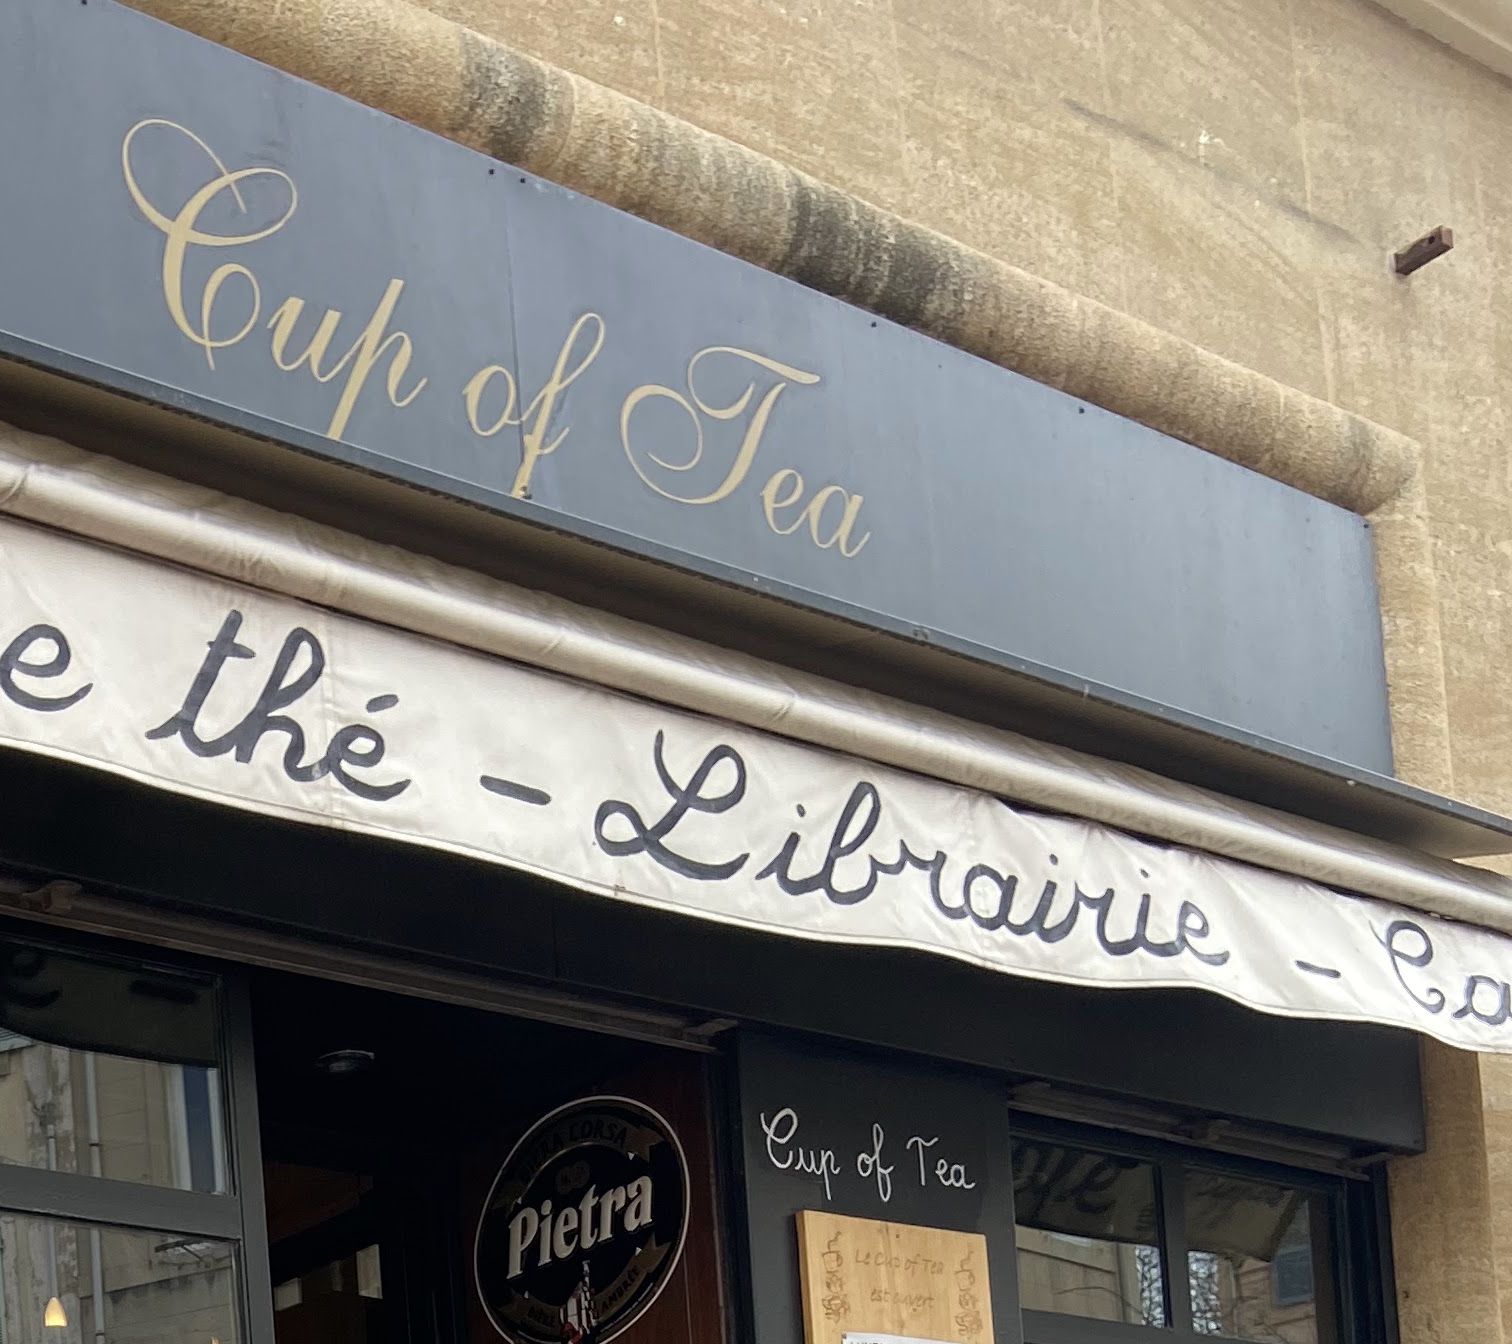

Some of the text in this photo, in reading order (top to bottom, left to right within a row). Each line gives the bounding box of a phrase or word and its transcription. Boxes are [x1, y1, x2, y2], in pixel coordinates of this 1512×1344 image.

[121, 118, 871, 558] Cup of Tea
[147, 609, 412, 801] thé
[595, 730, 1229, 966] Librairie
[506, 1175, 652, 1280] Pietra
[760, 1108, 840, 1200] Cup
[857, 1123, 895, 1201] of
[907, 1137, 976, 1189] Tea
